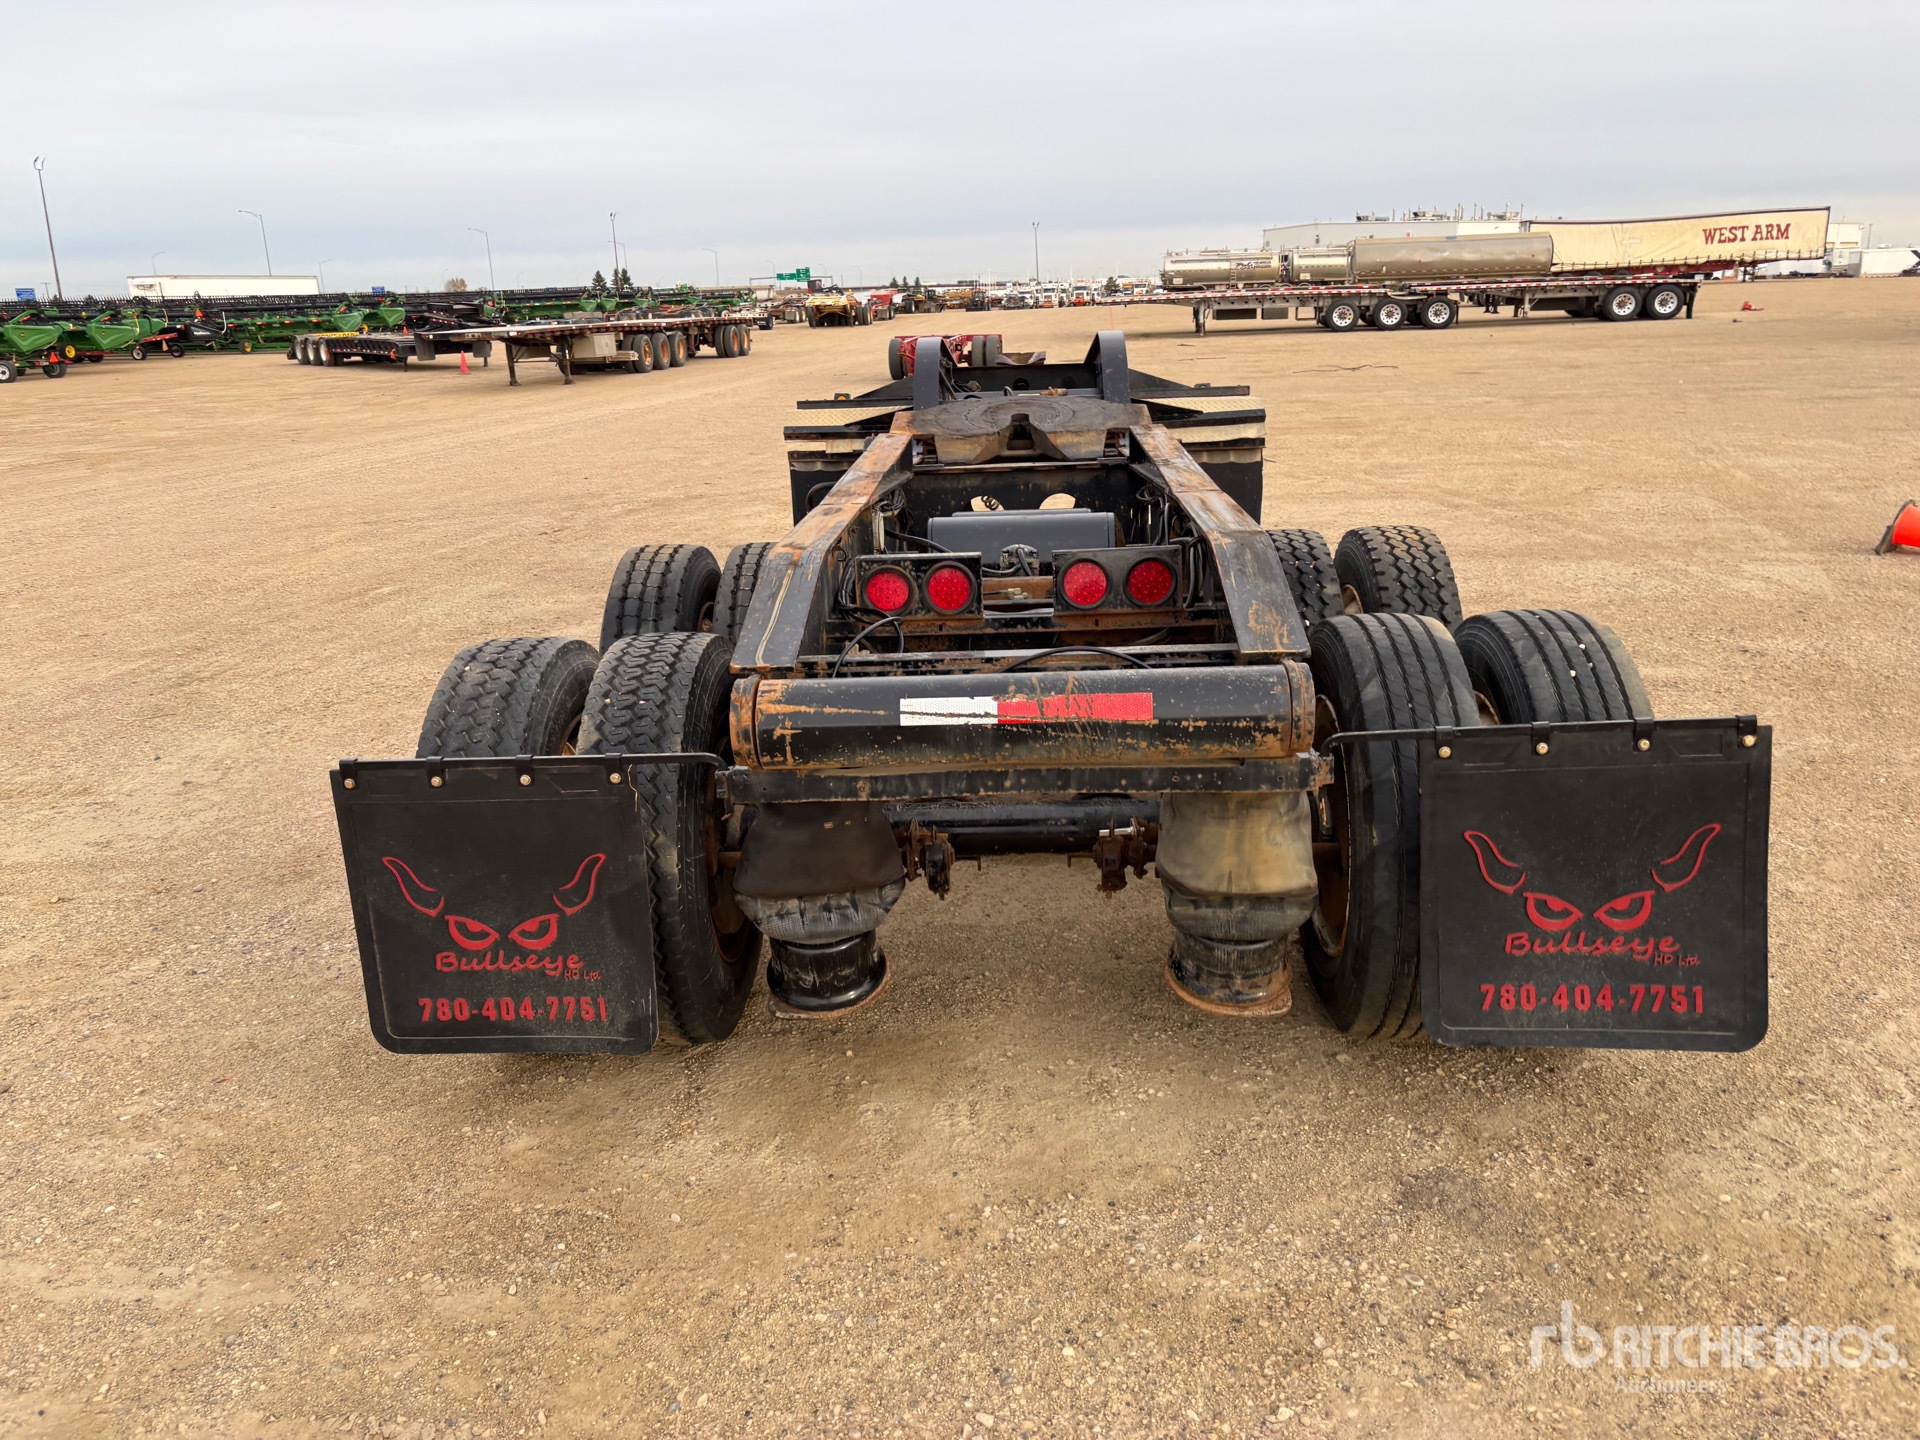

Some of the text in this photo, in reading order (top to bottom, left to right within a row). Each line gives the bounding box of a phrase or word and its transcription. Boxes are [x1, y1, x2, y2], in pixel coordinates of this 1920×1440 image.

[1702, 223, 1791, 245] WEST ARM
[1504, 931, 1681, 960] Bullseye
[435, 950, 584, 976] Bullseye
[1654, 953, 1674, 966] HD
[563, 969, 580, 980] HD
[418, 996, 608, 1023] 780-404-7751
[1479, 983, 1704, 1015] 780-404-7751
